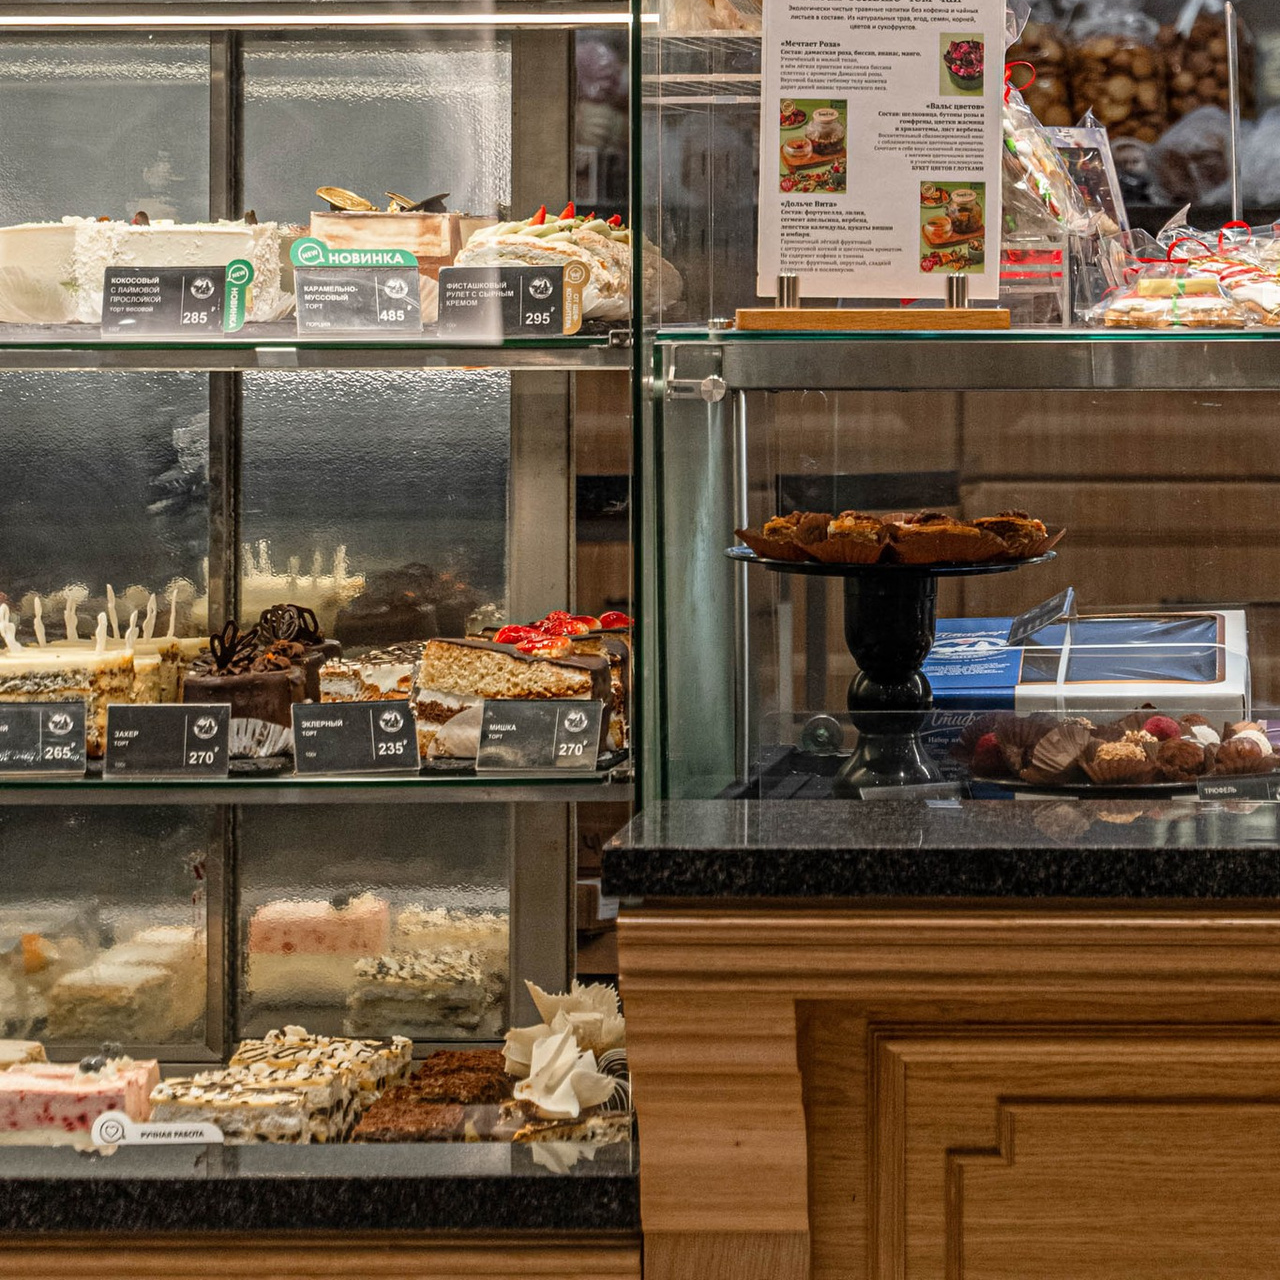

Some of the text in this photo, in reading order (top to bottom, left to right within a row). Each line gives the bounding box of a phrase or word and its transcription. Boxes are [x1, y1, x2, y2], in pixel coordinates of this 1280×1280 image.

[302, 249, 404, 264] NEW НОВИНКА
[111, 276, 160, 284] КОКОСОВЫЙ
[446, 281, 507, 289] ФИСТАШКОВЫЙ
[117, 286, 160, 294] ЛАЙМОВОЙ
[304, 285, 358, 293] КАРАМЕЛЬНО-
[479, 290, 514, 298] СЫРНЫМ
[228, 287, 239, 329] НОВИНКА
[182, 311, 208, 324] 285
[380, 310, 405, 321] 485
[525, 312, 550, 325] 295
[301, 719, 343, 729] ЭКЛЕРНЫЙ
[489, 723, 517, 732] МИШКА
[114, 730, 139, 738] ЗАХЕР
[45, 747, 71, 760] 265
[378, 742, 404, 755] 235
[559, 742, 584, 756] 270
[188, 751, 215, 764] 270
